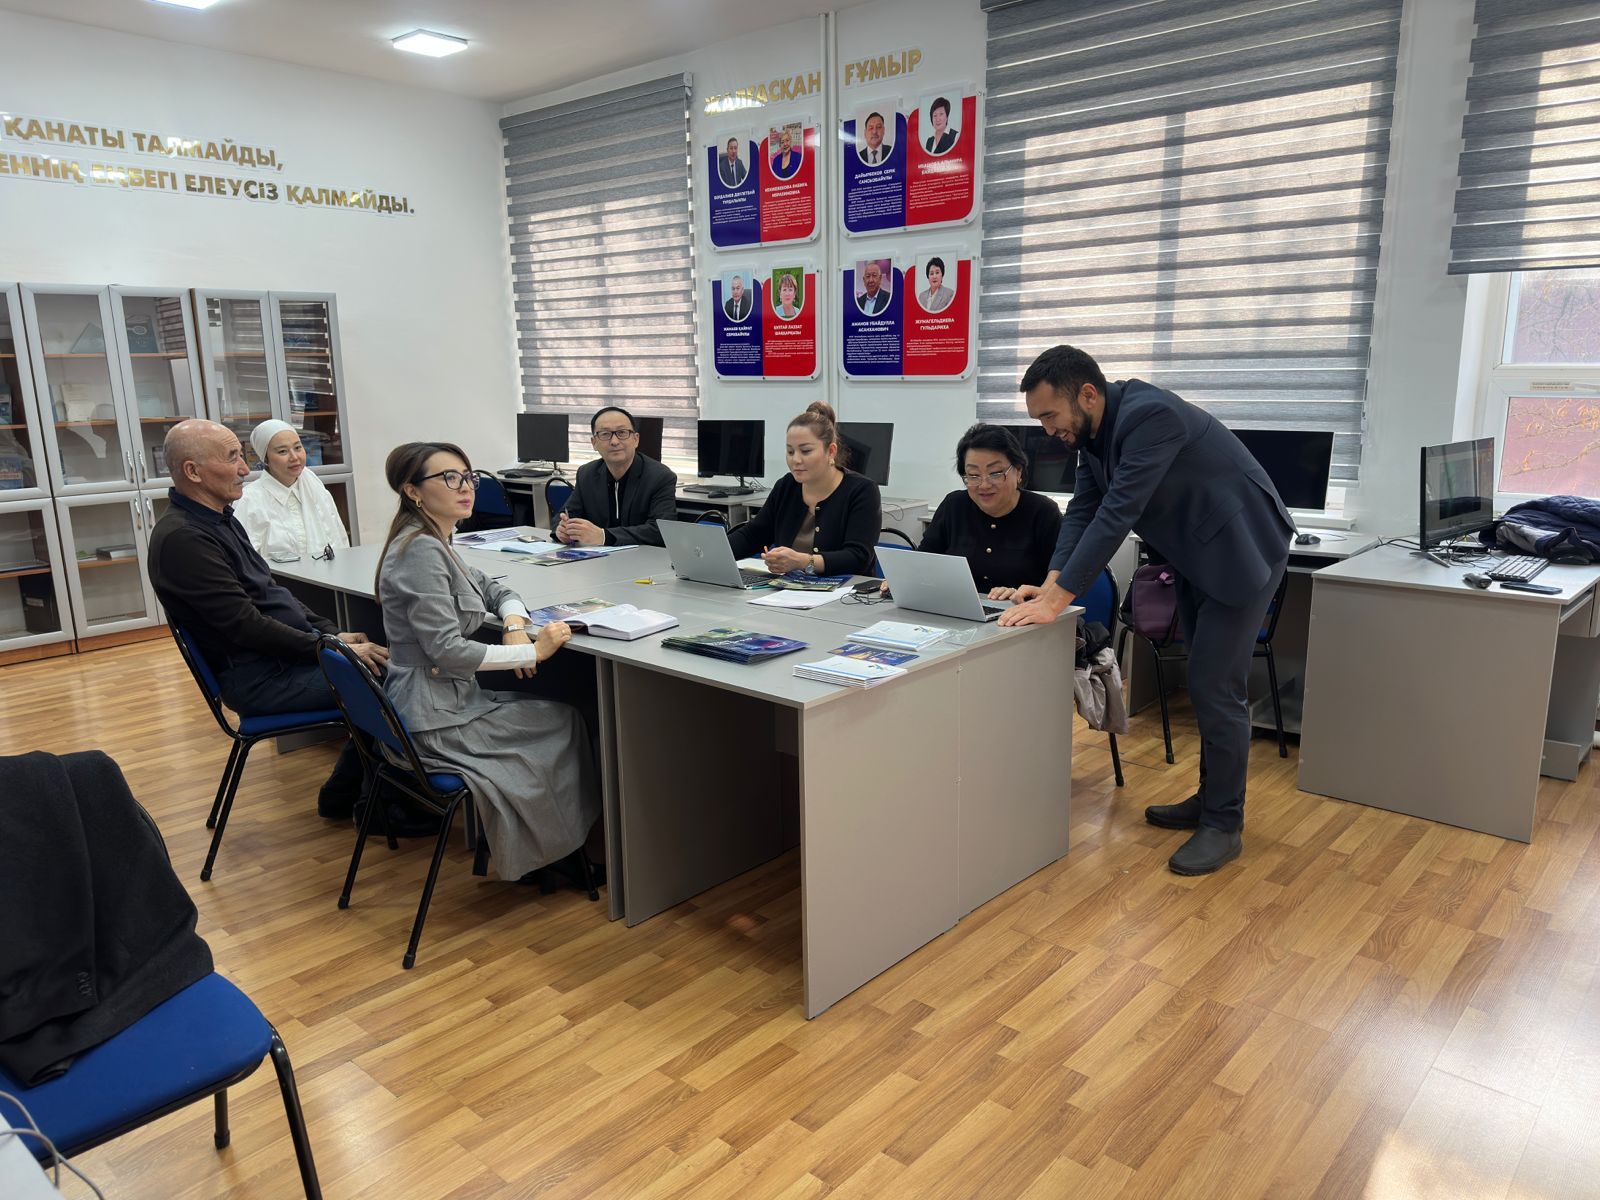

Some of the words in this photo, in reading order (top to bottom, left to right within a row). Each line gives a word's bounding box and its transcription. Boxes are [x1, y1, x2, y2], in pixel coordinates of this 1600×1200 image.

[844, 48, 922, 86] ҒҰМЫР
[132, 132, 283, 171] ТАЛМАЙДЫ,
[184, 174, 279, 201] ЕЛЕУСІЗ
[286, 184, 415, 214] ҚАЛМАЙДЫ.
